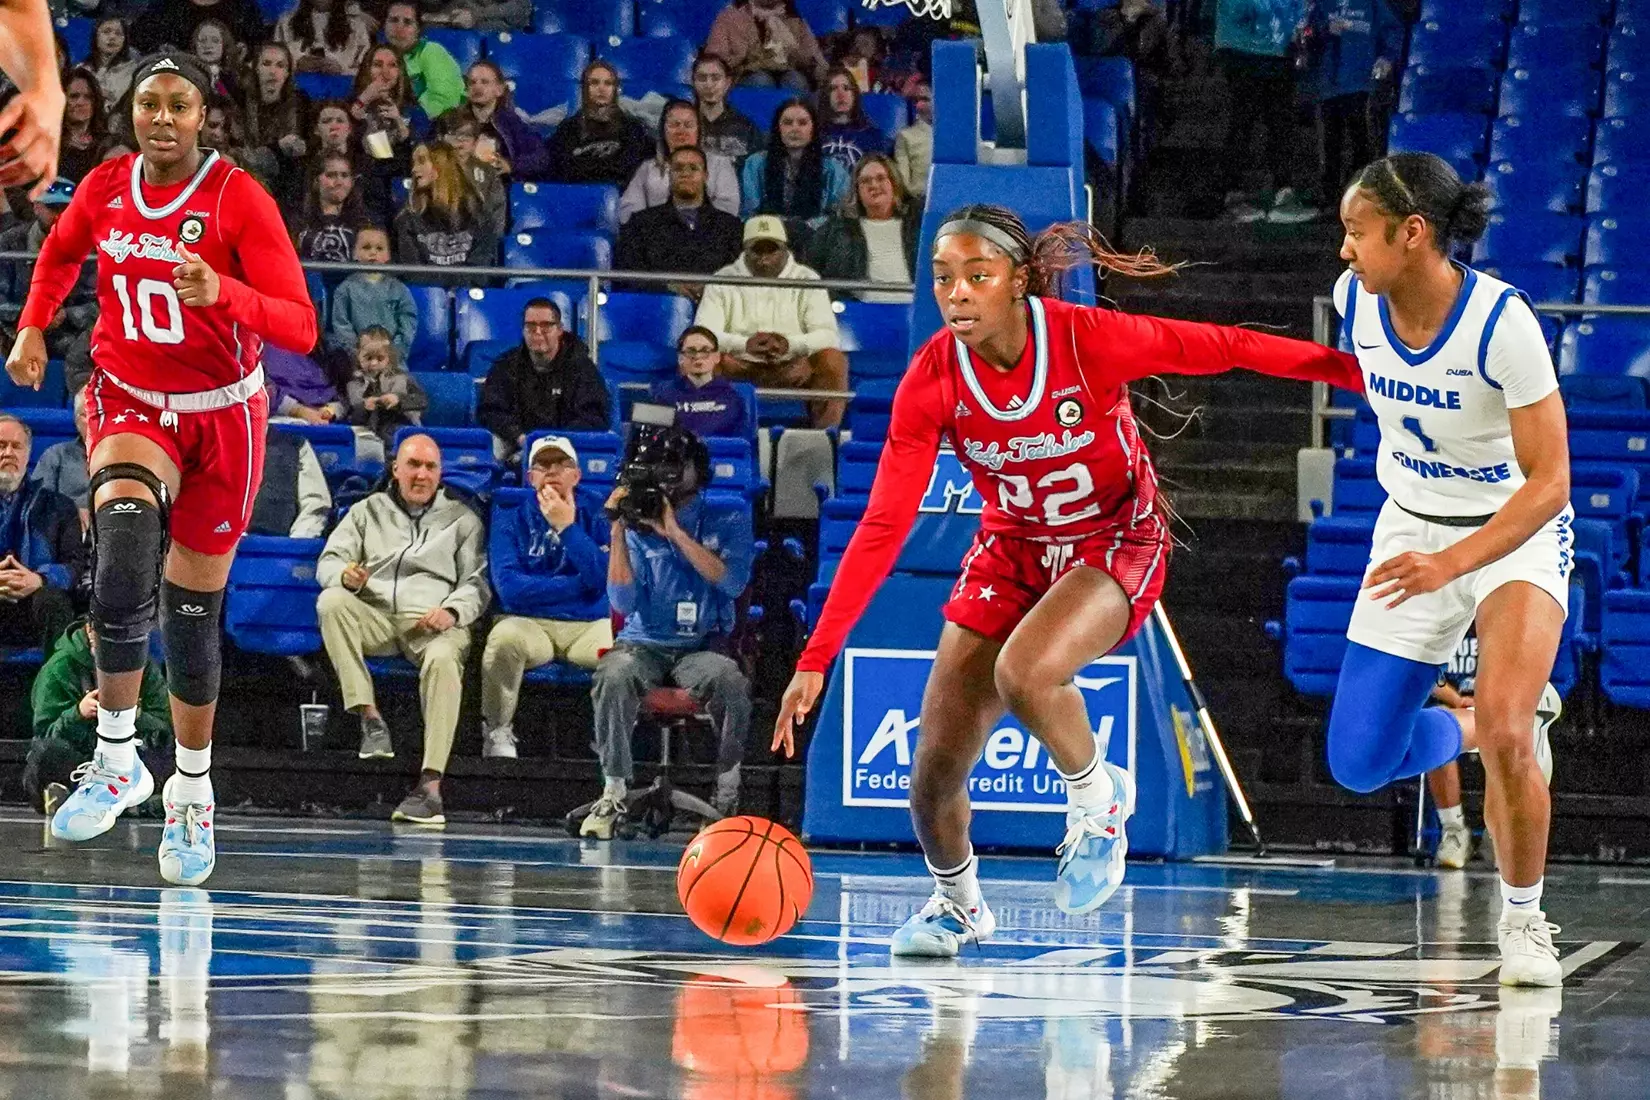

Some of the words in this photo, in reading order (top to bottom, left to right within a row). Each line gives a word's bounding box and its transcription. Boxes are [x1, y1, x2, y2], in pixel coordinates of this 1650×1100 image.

[100, 228, 136, 264] Lady
[112, 274, 185, 344] 10
[1369, 372, 1461, 410] MIDDLE
[964, 438, 1006, 471] Lady
[1004, 429, 1096, 463] Techsters
[1402, 416, 1437, 452] 1
[987, 462, 1101, 527] 22
[855, 768, 911, 790] Fede
[969, 773, 1024, 794] redit
